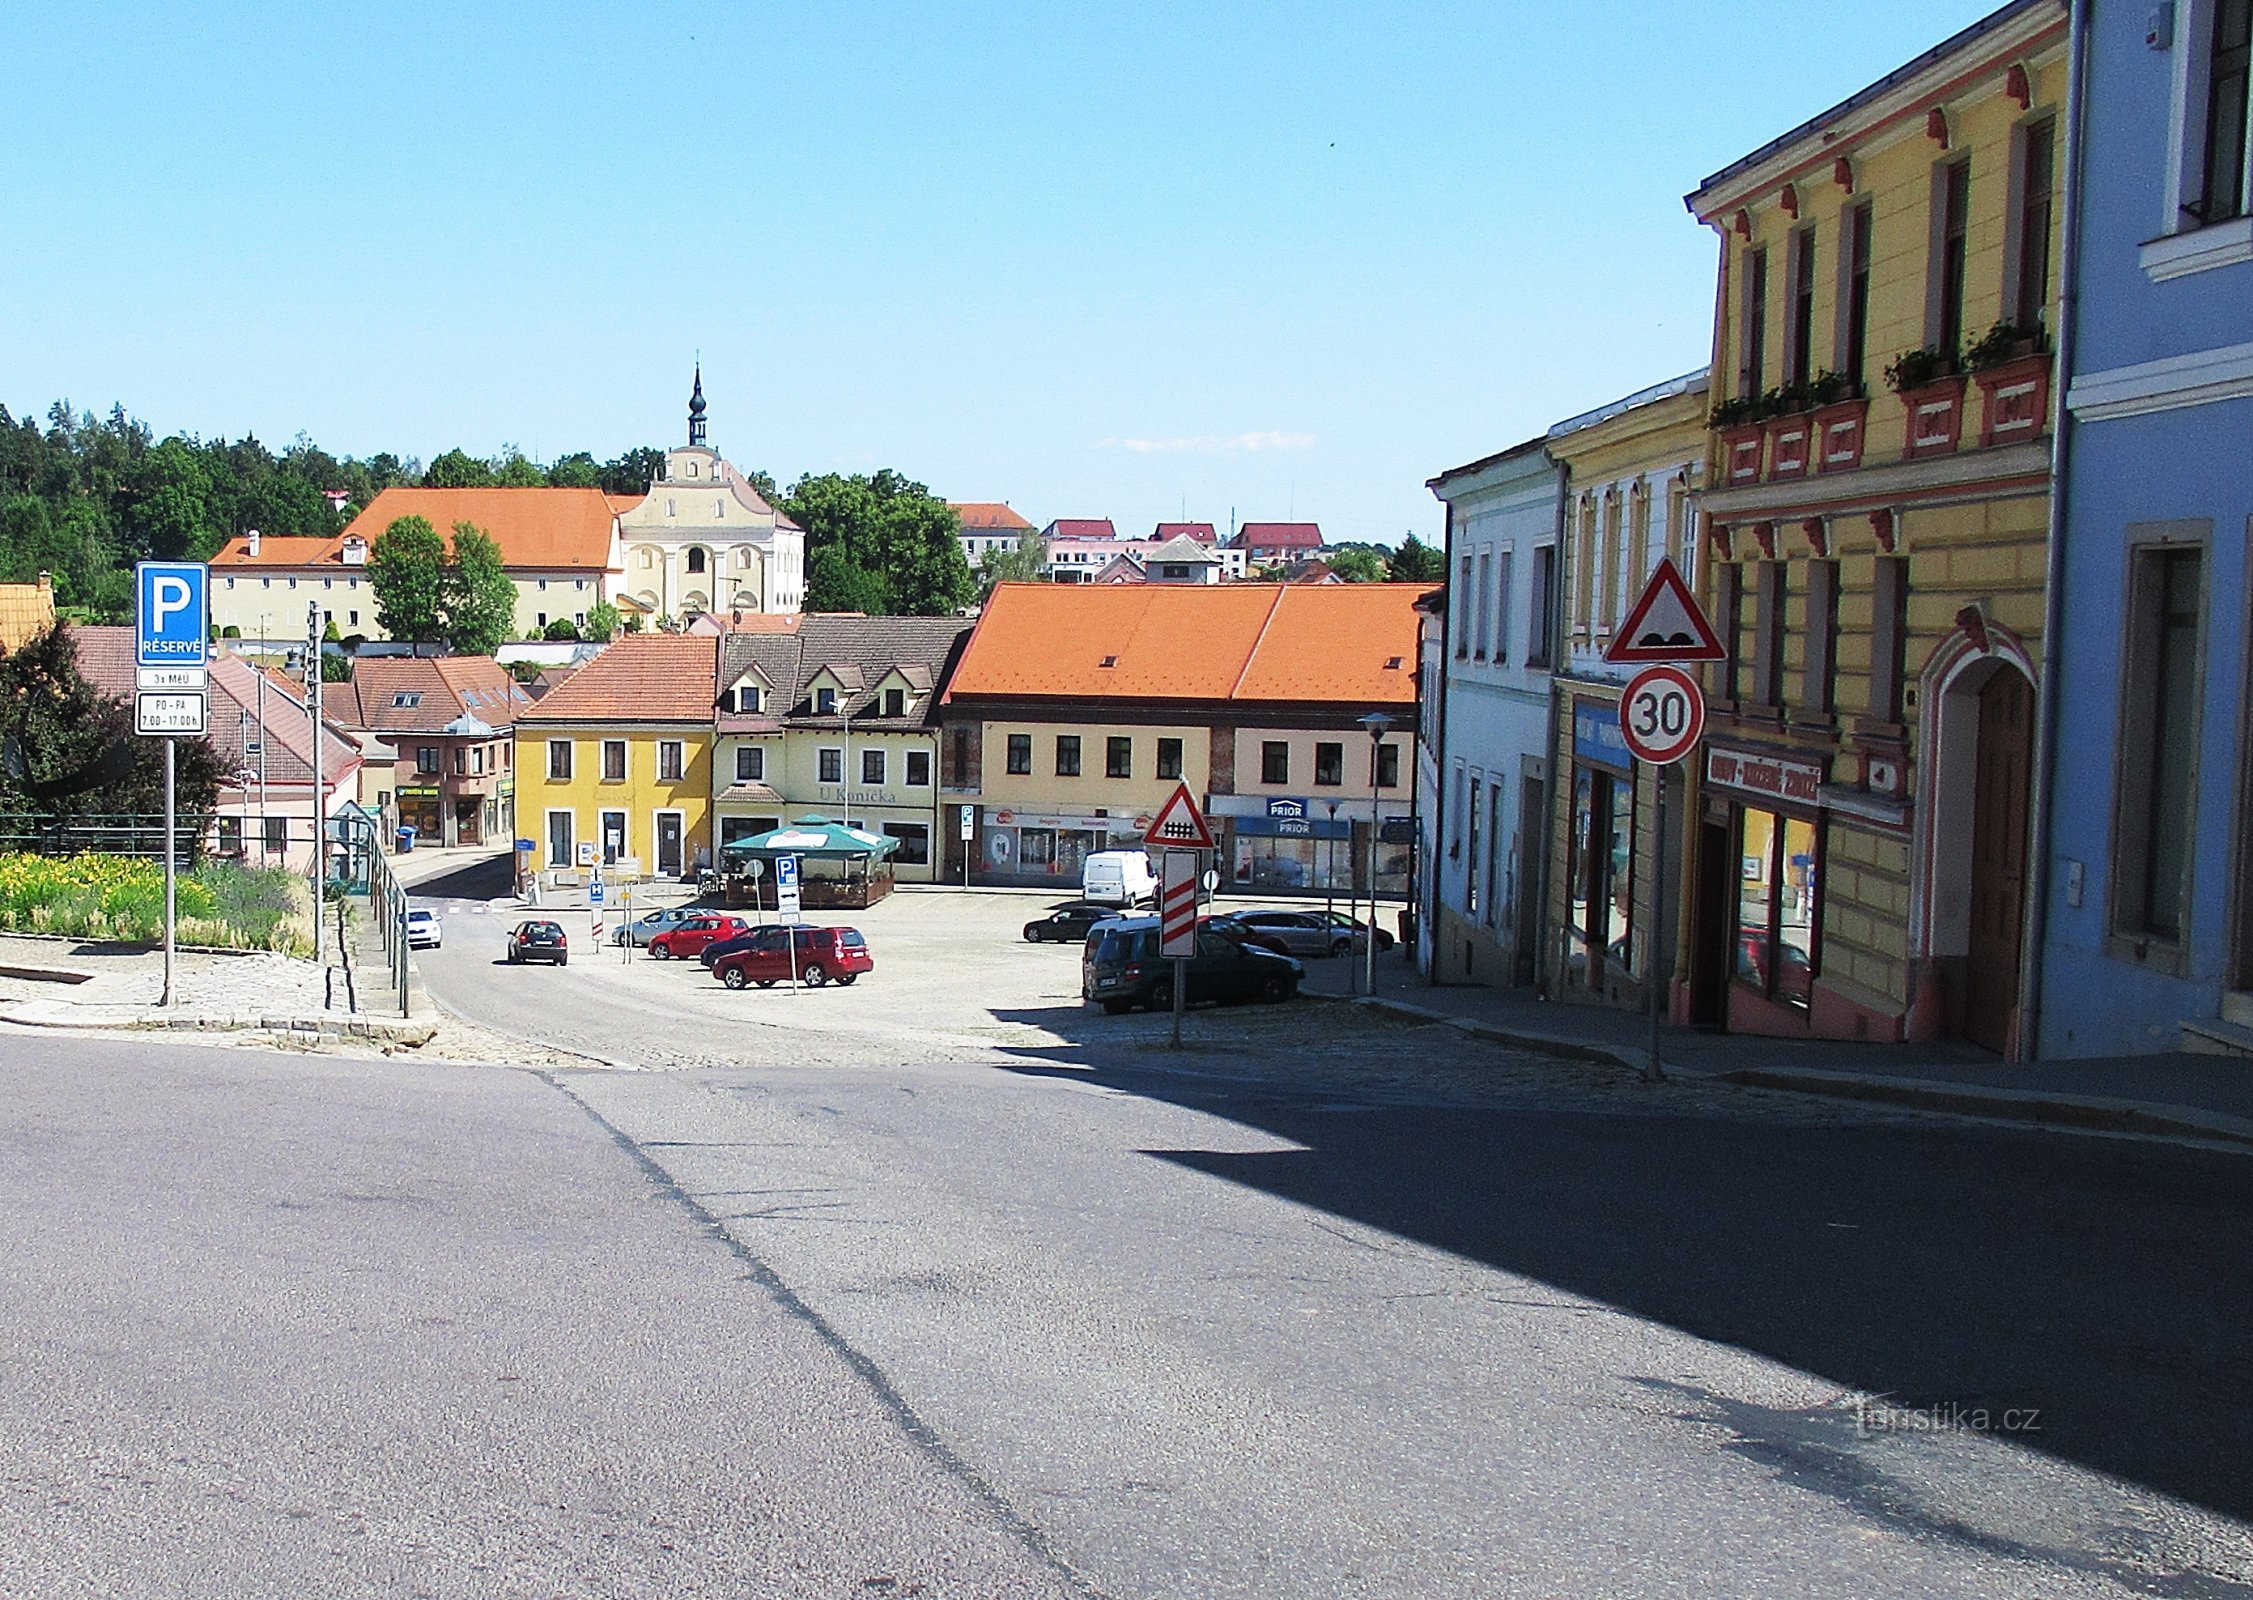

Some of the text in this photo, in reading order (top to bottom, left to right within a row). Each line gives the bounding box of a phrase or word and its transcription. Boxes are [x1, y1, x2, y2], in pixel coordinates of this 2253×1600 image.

[153, 576, 192, 633] P
[143, 637, 201, 653] RÉSERVÉ
[154, 674, 165, 684] 3x
[156, 699, 167, 710] PO
[1634, 691, 1684, 737] 30
[819, 787, 831, 800] U
[1270, 806, 1303, 817] PRIOR
[1279, 823, 1311, 834] PRIOR
[779, 860, 793, 878] P
[591, 884, 602, 895] H
